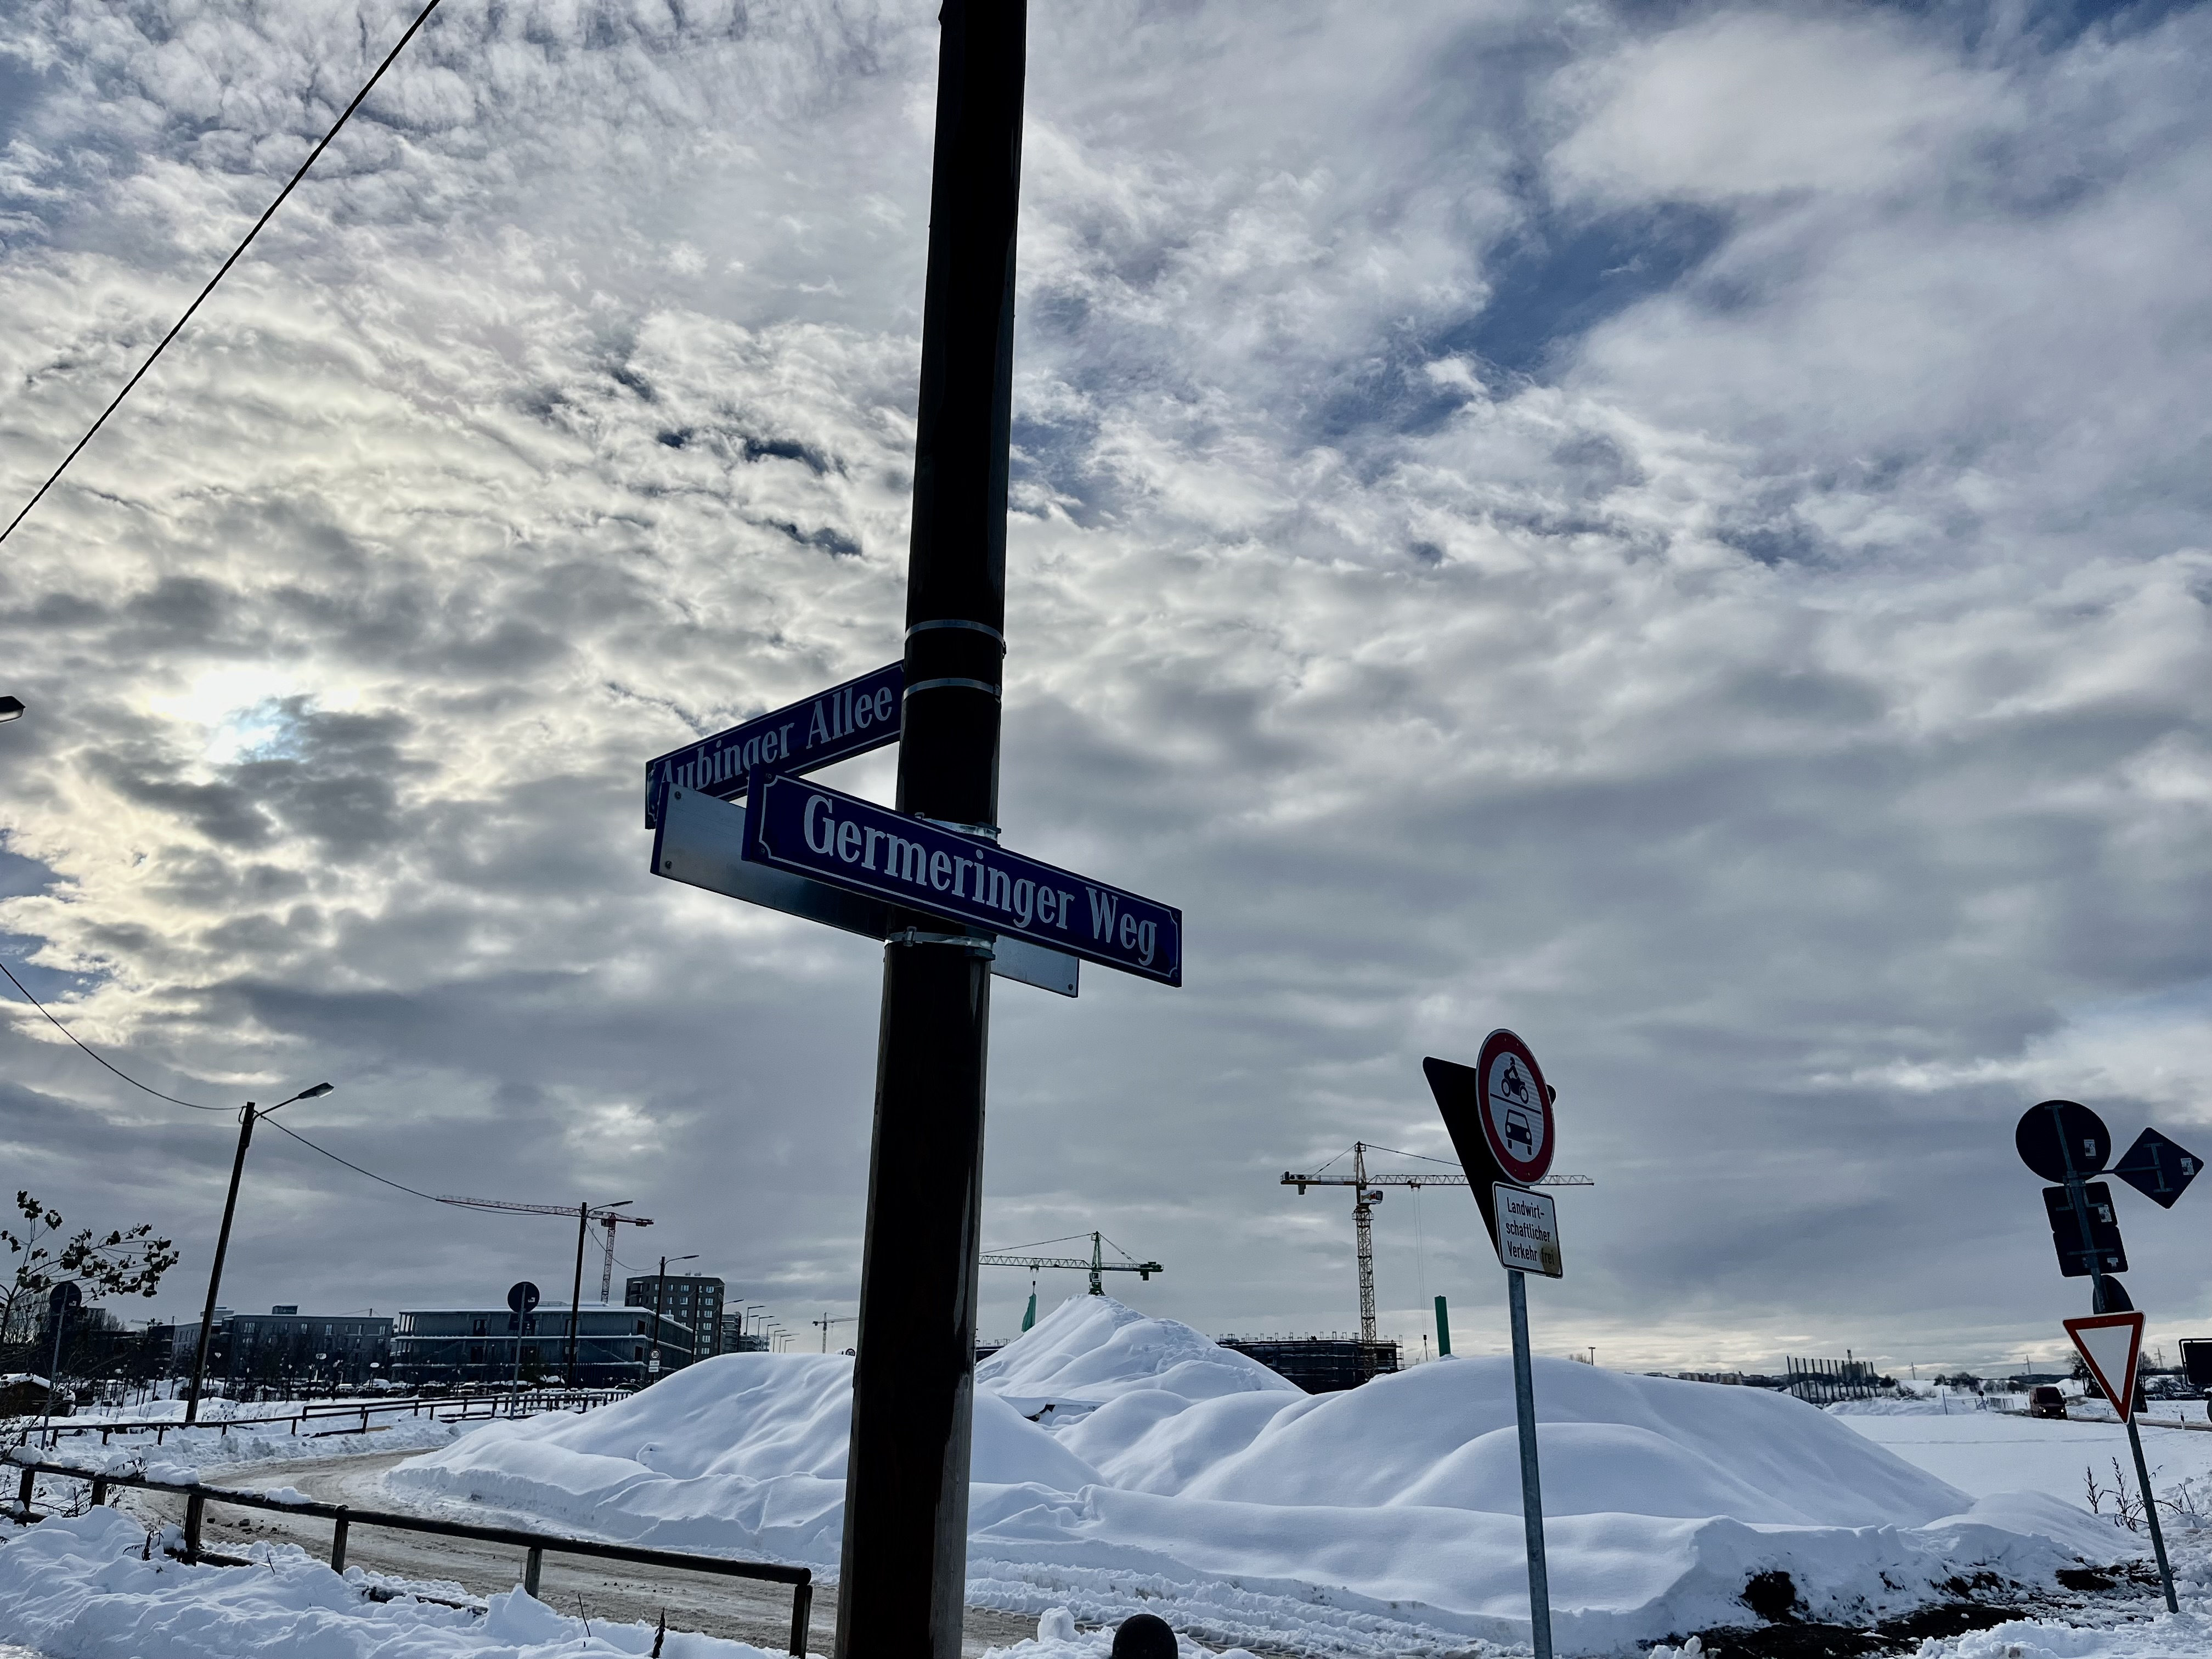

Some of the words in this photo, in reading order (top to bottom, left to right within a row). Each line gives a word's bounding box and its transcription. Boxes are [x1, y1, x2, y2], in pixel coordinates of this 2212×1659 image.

[806, 686, 893, 749] Allee
[804, 794, 1075, 930] Germeringer
[1086, 886, 1157, 966] Weg
[1506, 1197, 1545, 1219] Landwirt-
[1505, 1220, 1550, 1243] schaftlicher
[1506, 1240, 1538, 1261] Verkehr
[1541, 1248, 1555, 1265] frei
